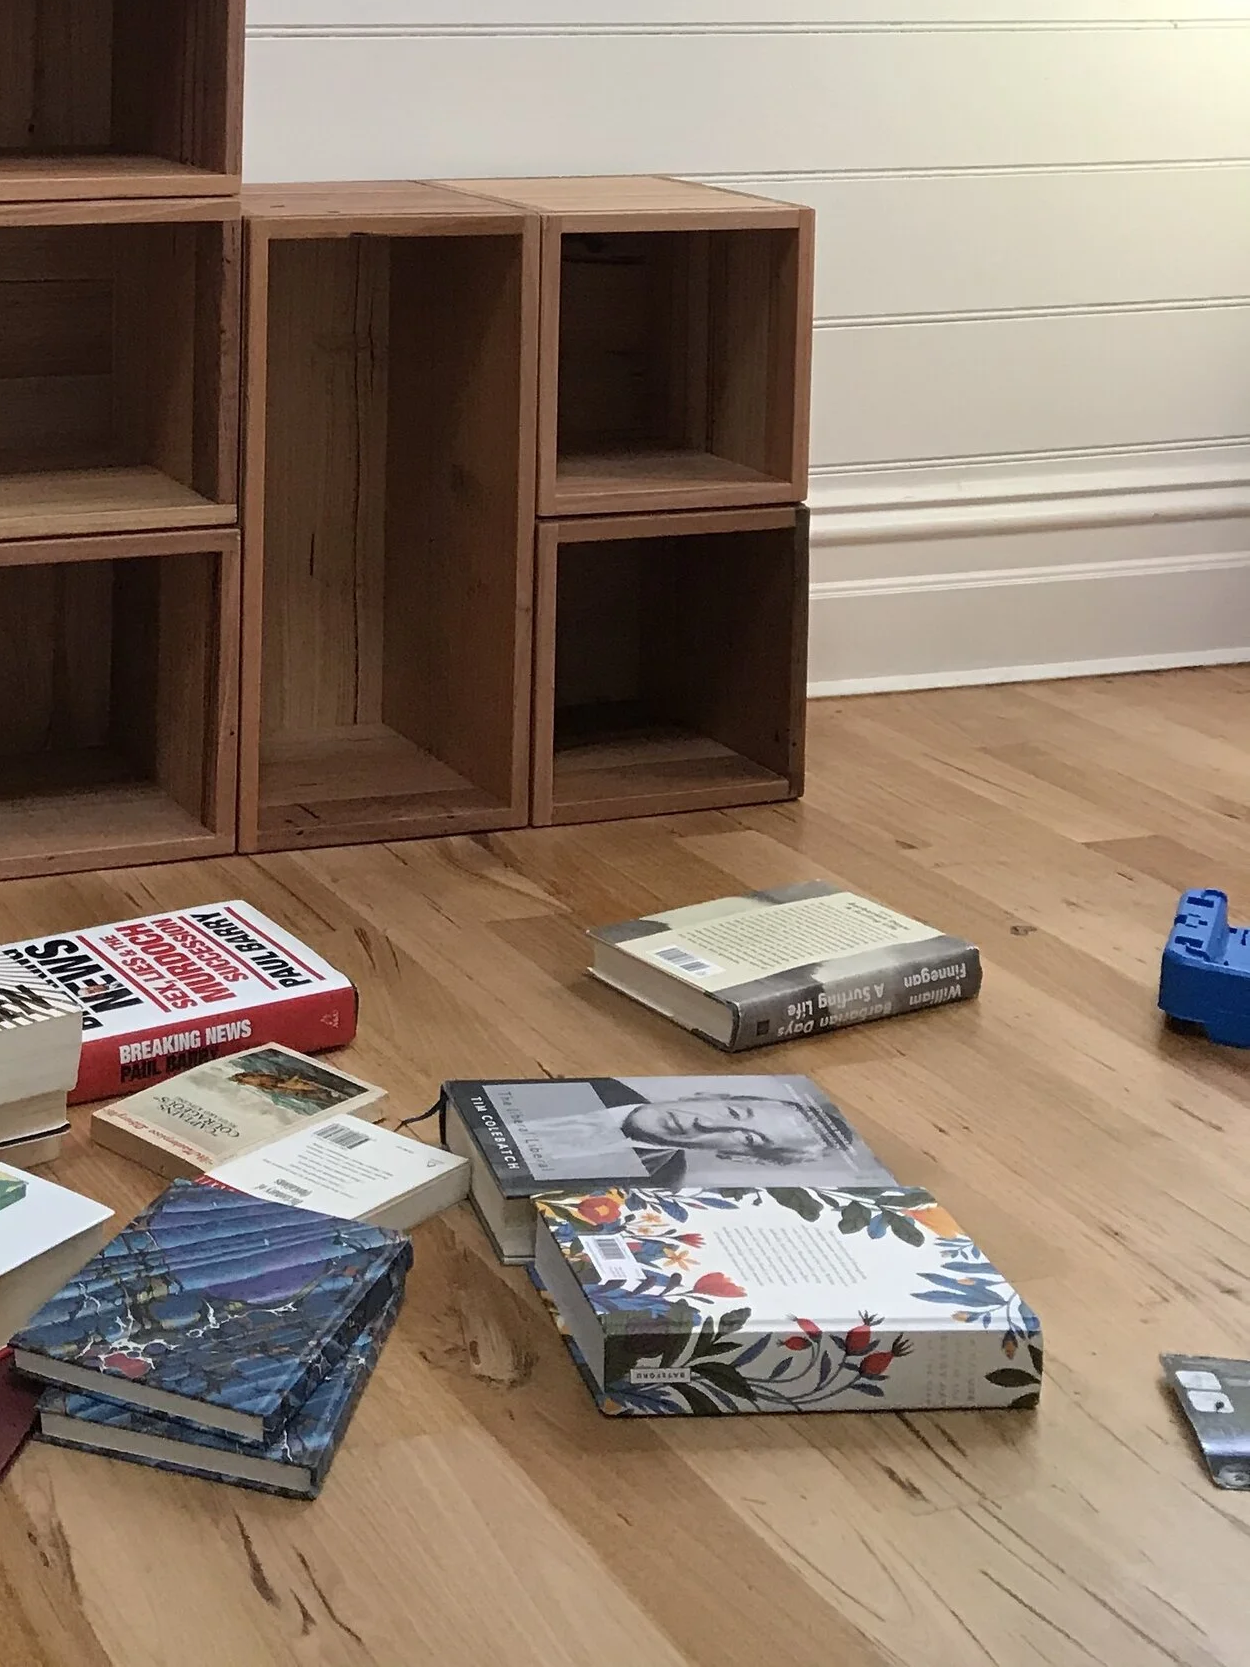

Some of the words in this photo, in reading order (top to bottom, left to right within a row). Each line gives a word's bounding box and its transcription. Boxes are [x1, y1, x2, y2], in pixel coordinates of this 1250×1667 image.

[99, 934, 129, 951] THE
[189, 911, 268, 953] BARRY
[114, 923, 238, 1003] MURDOCH
[150, 917, 249, 983] SUCCESSION
[24, 938, 145, 1014] NEWS
[121, 956, 162, 982] LIES
[250, 953, 313, 988] PAUL
[903, 962, 967, 988] Finnegan
[818, 985, 871, 1009] Surfing
[873, 982, 885, 998] A
[909, 983, 962, 1006] William
[787, 1000, 814, 1020] Life
[819, 1000, 892, 1028] Barbarian
[777, 1019, 815, 1037] Days
[119, 1029, 201, 1065] BREAKING
[205, 1019, 252, 1045] NEWS
[120, 1060, 162, 1083] PAUL
[470, 1095, 488, 1113] TIM
[481, 1114, 521, 1170] COLEBATCH
